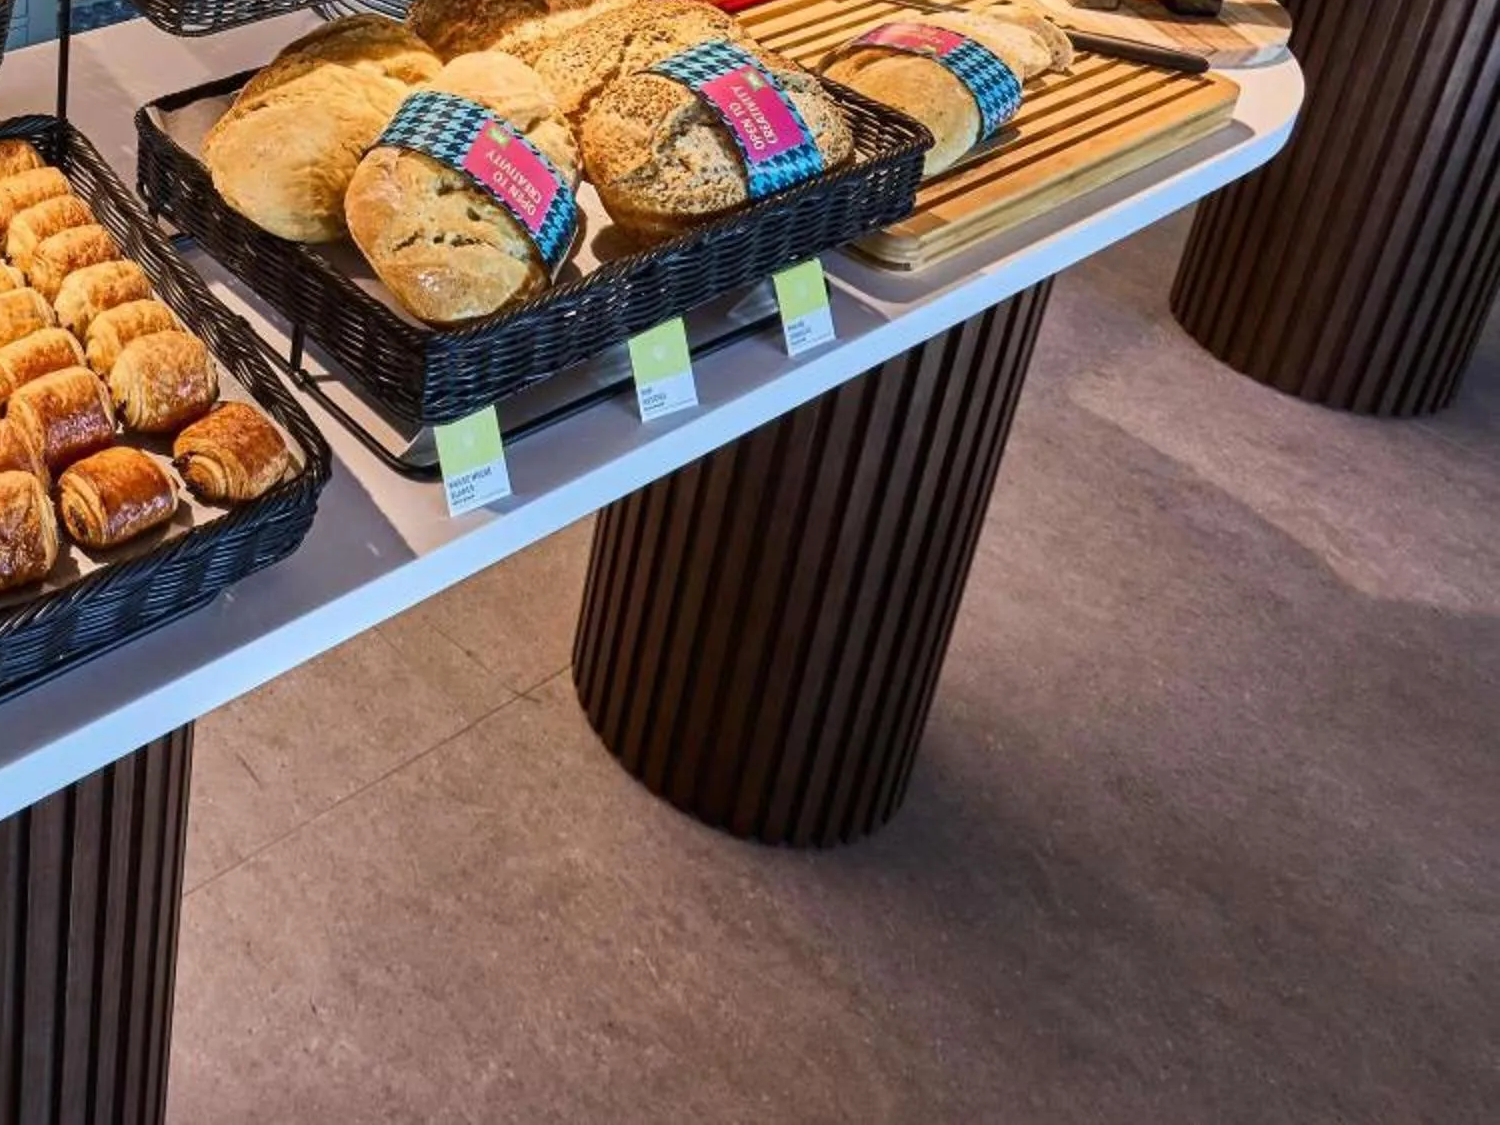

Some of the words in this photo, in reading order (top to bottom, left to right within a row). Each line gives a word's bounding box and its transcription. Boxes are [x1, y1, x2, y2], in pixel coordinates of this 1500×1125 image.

[728, 102, 745, 117] TO
[730, 85, 778, 144] CREATIVITY
[741, 118, 765, 151] OPEN
[485, 150, 542, 204] CREATIVITY
[493, 170, 509, 188] TO
[508, 184, 536, 216] OPEN
